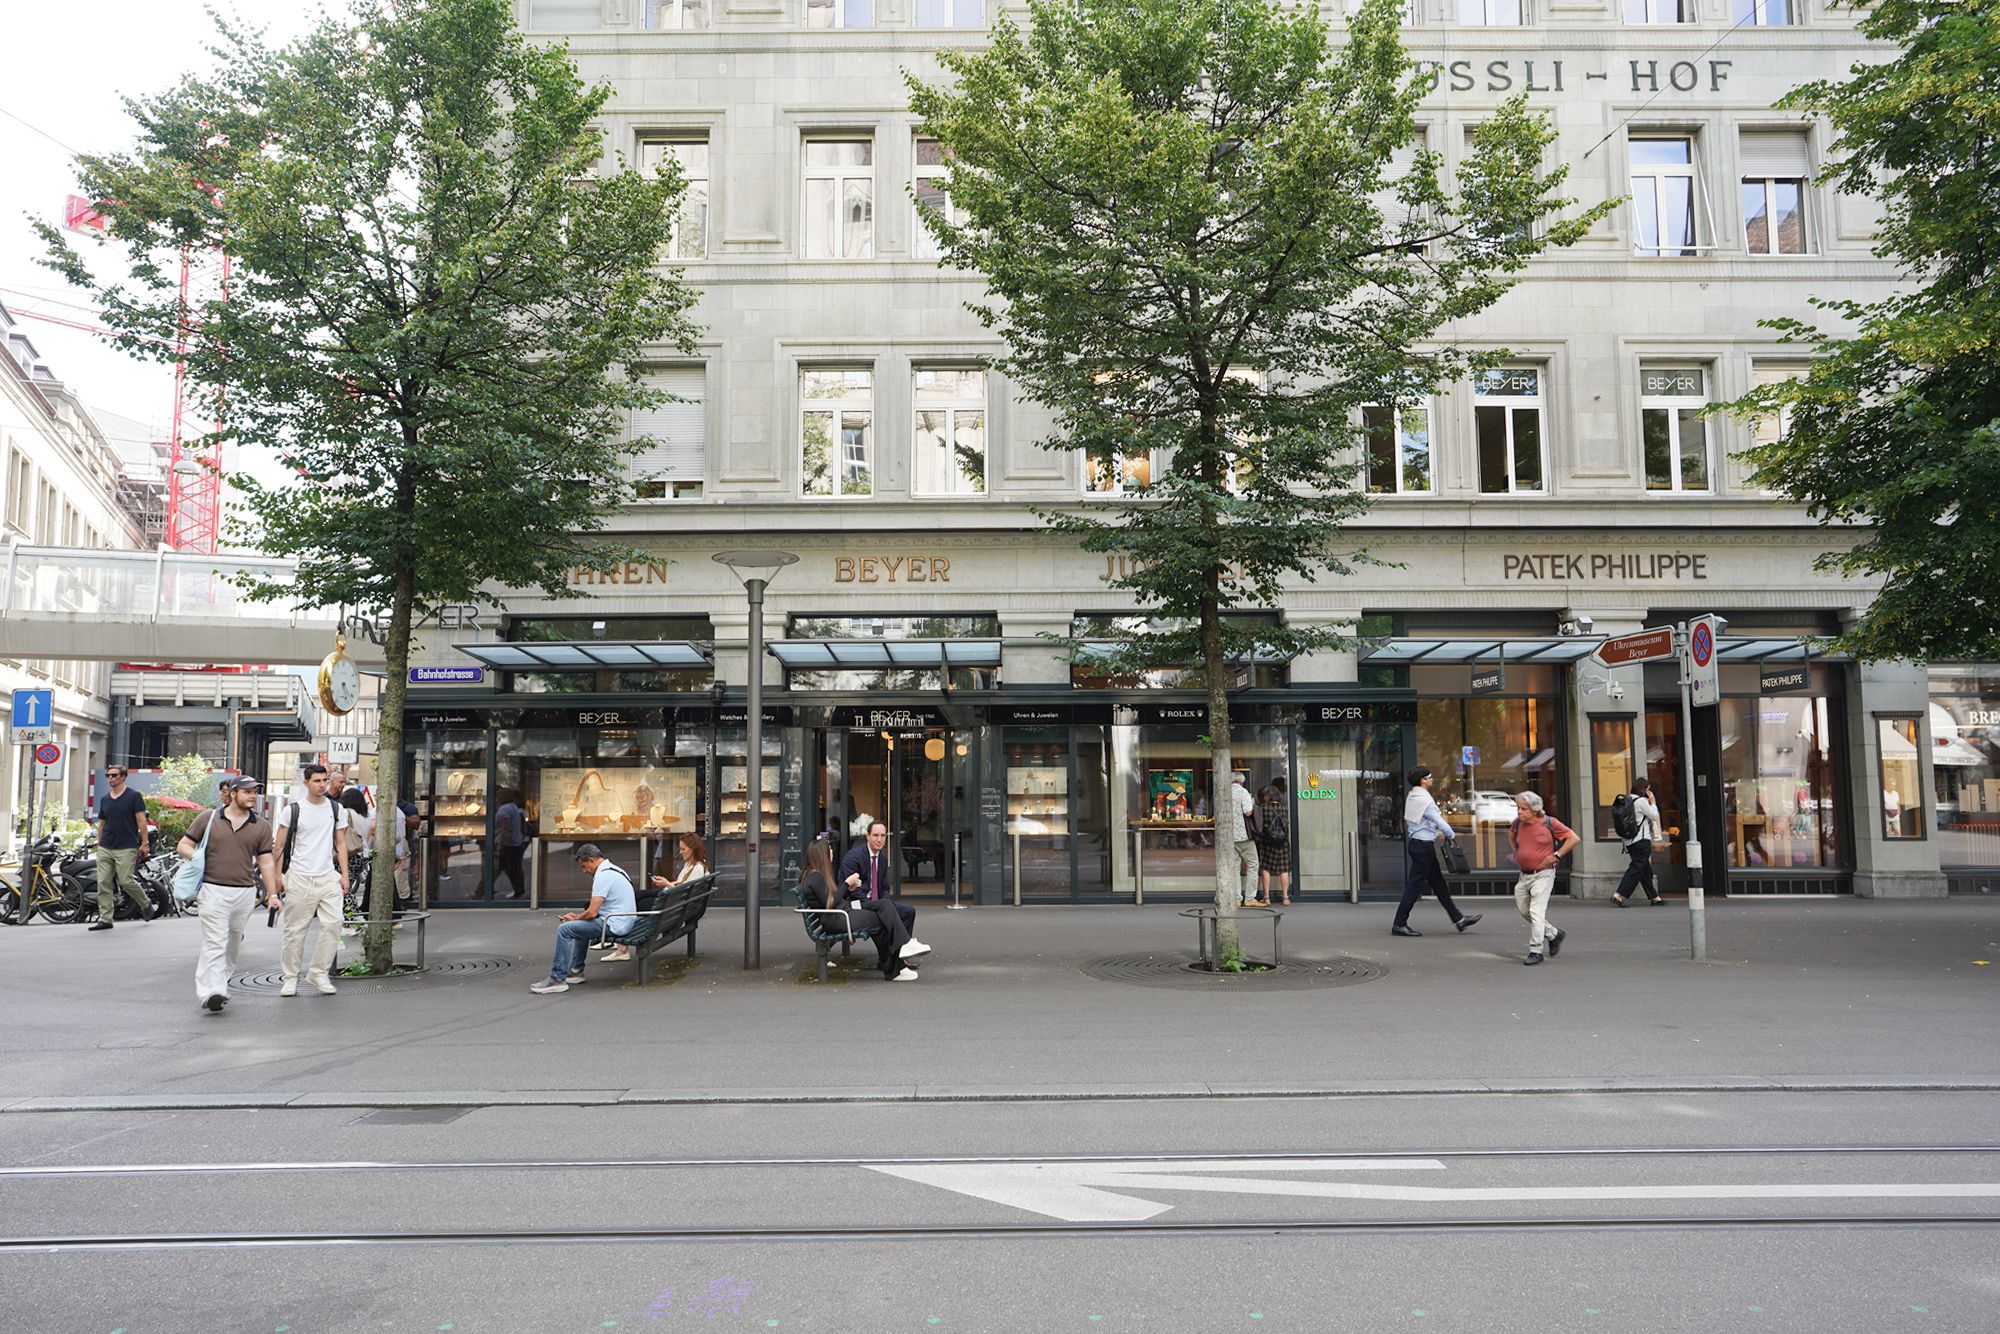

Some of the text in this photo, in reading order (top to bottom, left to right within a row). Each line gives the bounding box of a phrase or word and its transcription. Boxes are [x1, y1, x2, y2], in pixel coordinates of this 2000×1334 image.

[1414, 60, 1564, 92] ÜSSLI
[1629, 60, 1733, 92] HOF
[1482, 376, 1530, 390] BEYER
[1647, 377, 1696, 390] BEYER
[562, 560, 669, 585] HREN
[835, 557, 951, 582] BEYER
[1504, 554, 1708, 580] PATEK PHILIPPE
[1613, 636, 1662, 651] Uhrenmuseum
[1629, 648, 1649, 660] Beyer
[418, 668, 474, 679] Bahnhofstrasse
[1762, 674, 1803, 688] PATEK PHILIPPE
[579, 712, 620, 724] BEYER
[1167, 710, 1196, 718] ROLEX
[1321, 707, 1363, 719] BEYER
[1969, 711, 2000, 724] BRE
[332, 742, 354, 752] TAXI
